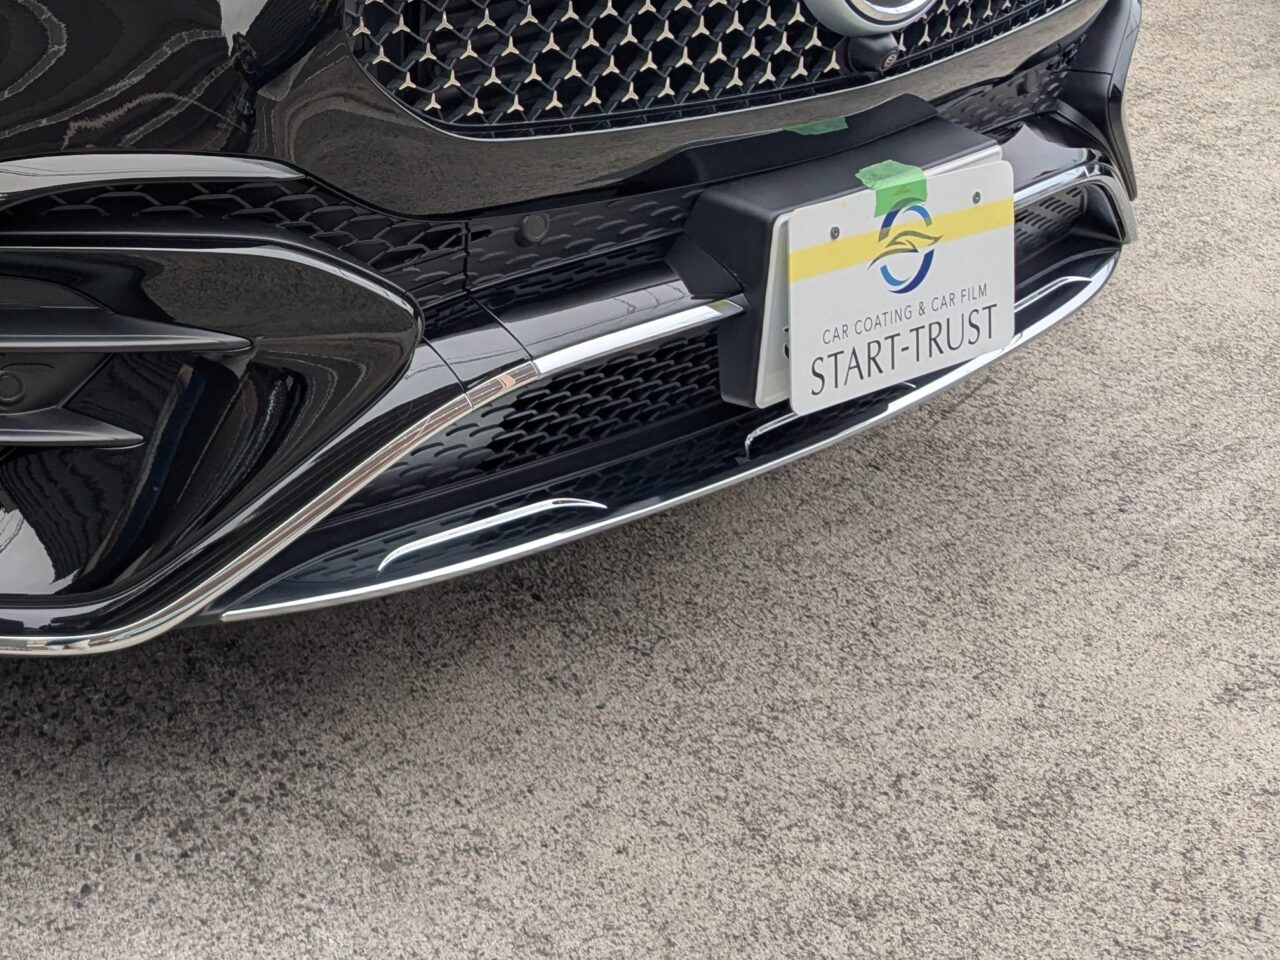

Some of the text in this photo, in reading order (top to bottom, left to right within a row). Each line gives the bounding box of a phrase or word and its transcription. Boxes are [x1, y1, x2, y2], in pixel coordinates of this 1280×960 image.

[811, 303, 998, 396] START-TRUST
[822, 283, 988, 345] CAR COATING & CAR FILM
